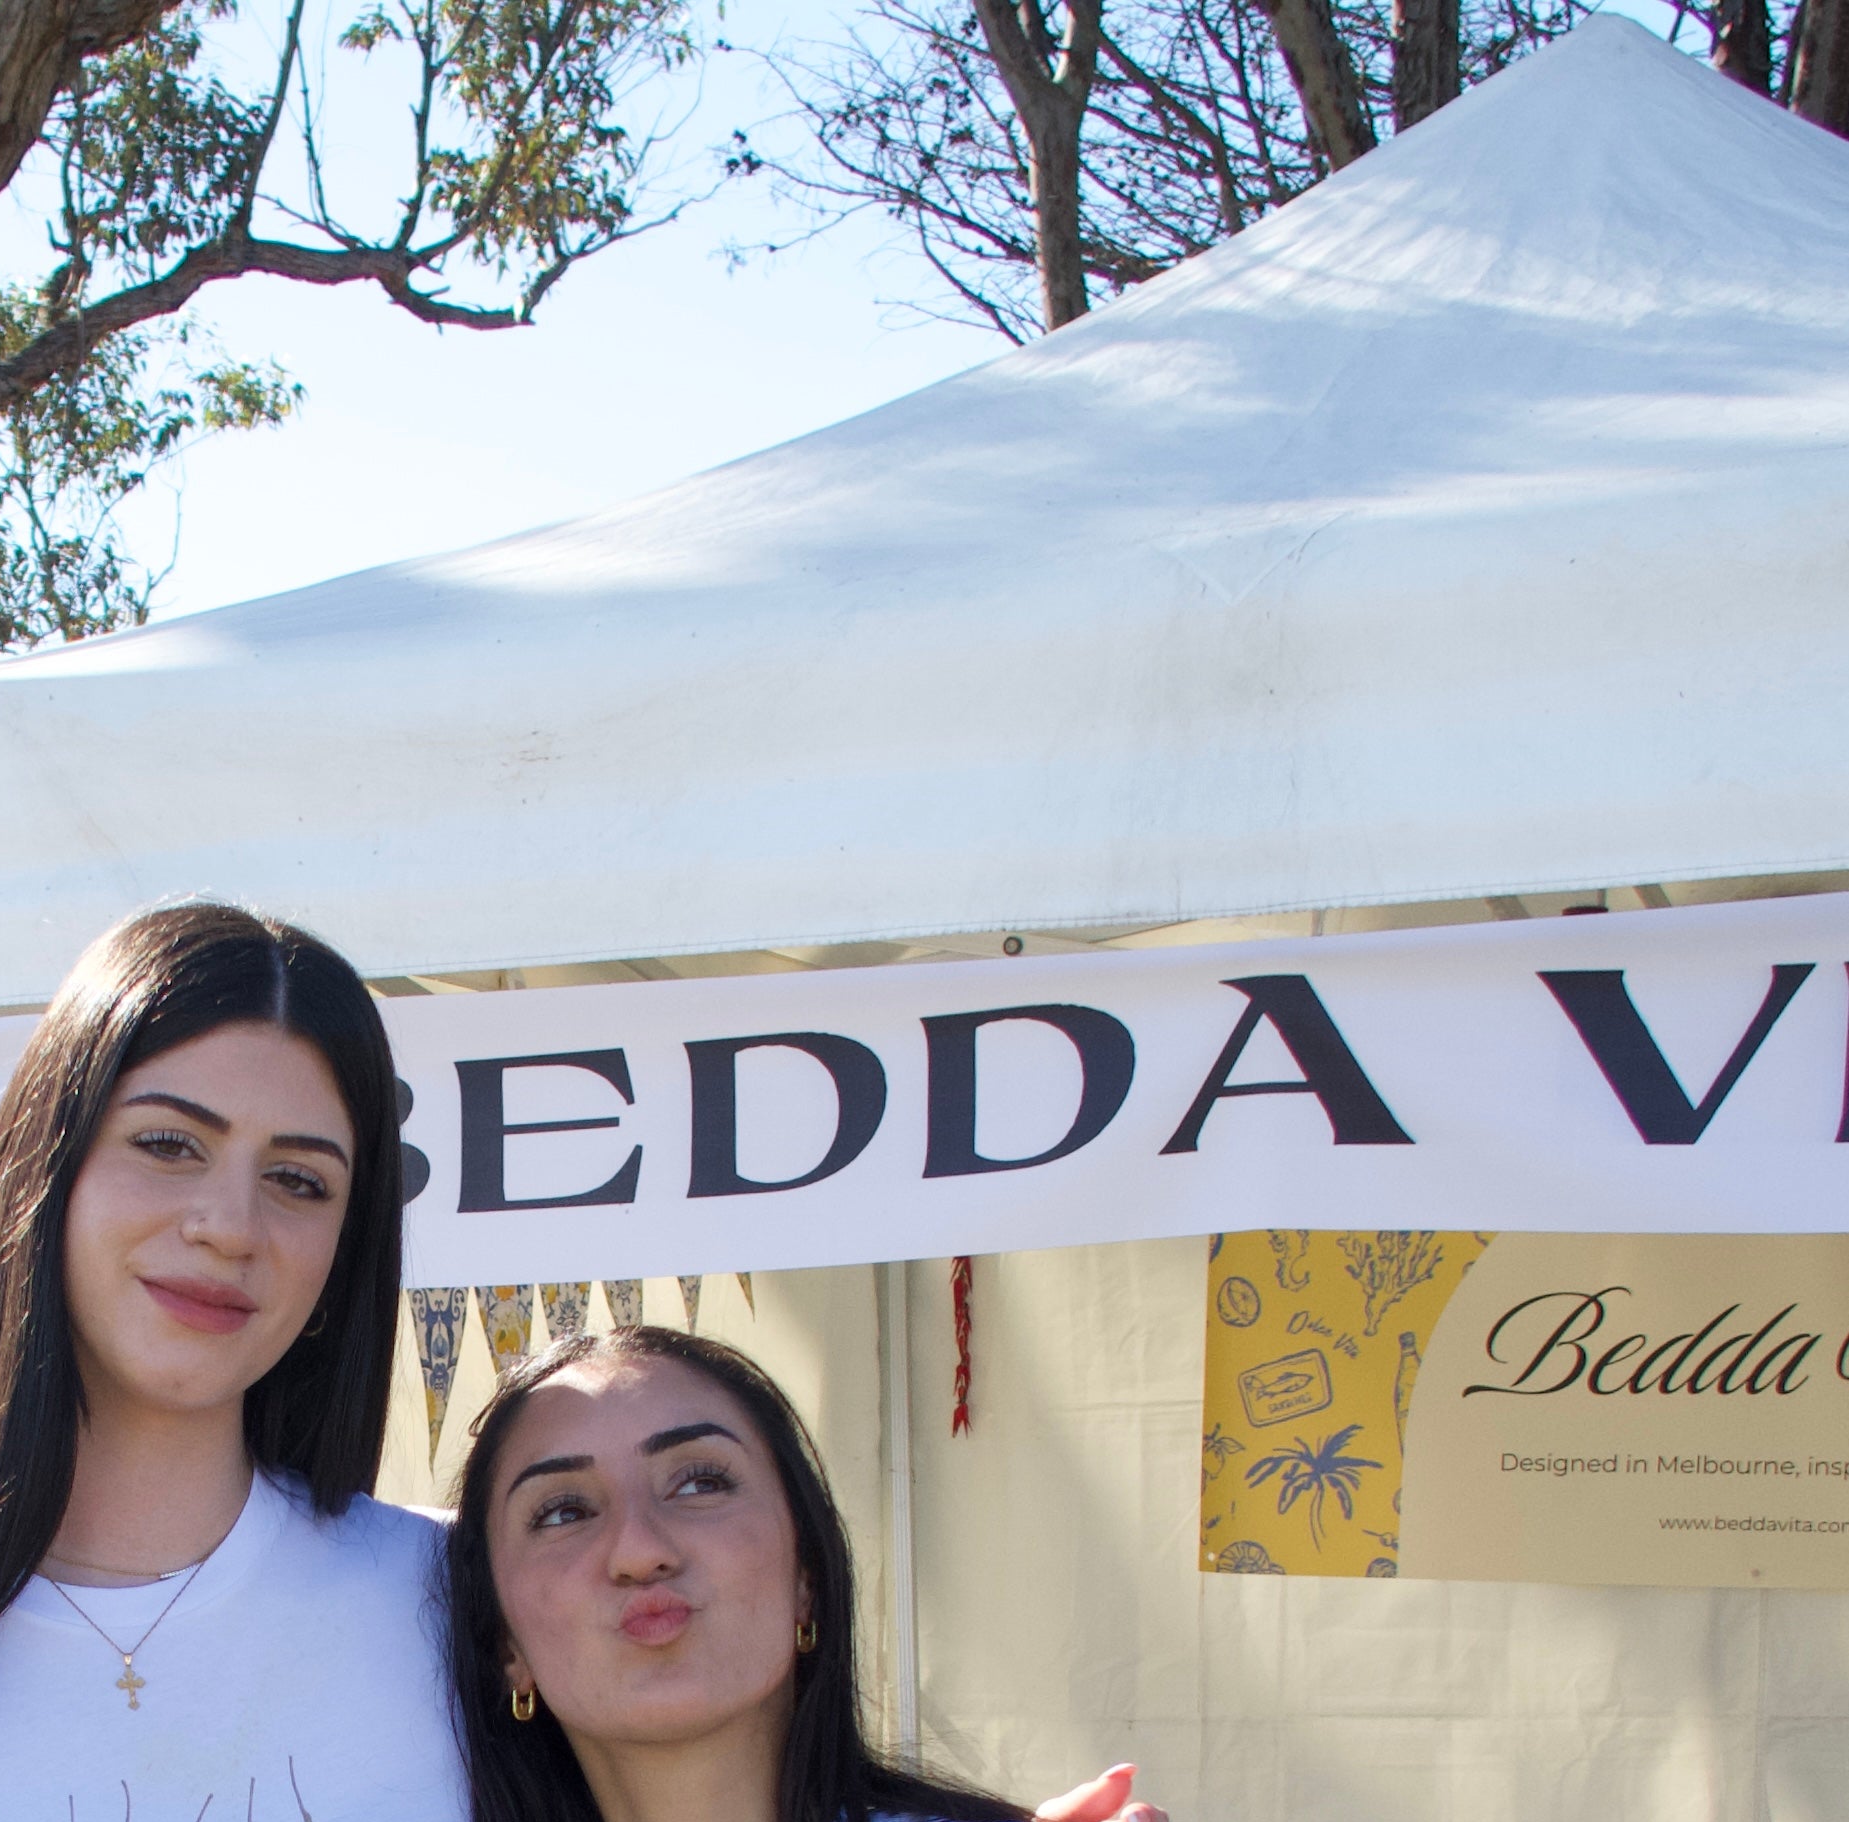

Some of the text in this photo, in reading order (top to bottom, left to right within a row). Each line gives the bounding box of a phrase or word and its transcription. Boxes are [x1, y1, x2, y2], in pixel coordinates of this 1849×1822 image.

[395, 962, 1849, 1214] EDDA V
[1462, 1286, 1822, 1398] Bedda
[1501, 1453, 1618, 1477] Designed
[1626, 1454, 1648, 1474] in
[1657, 1455, 1802, 1479] Melbourne,
